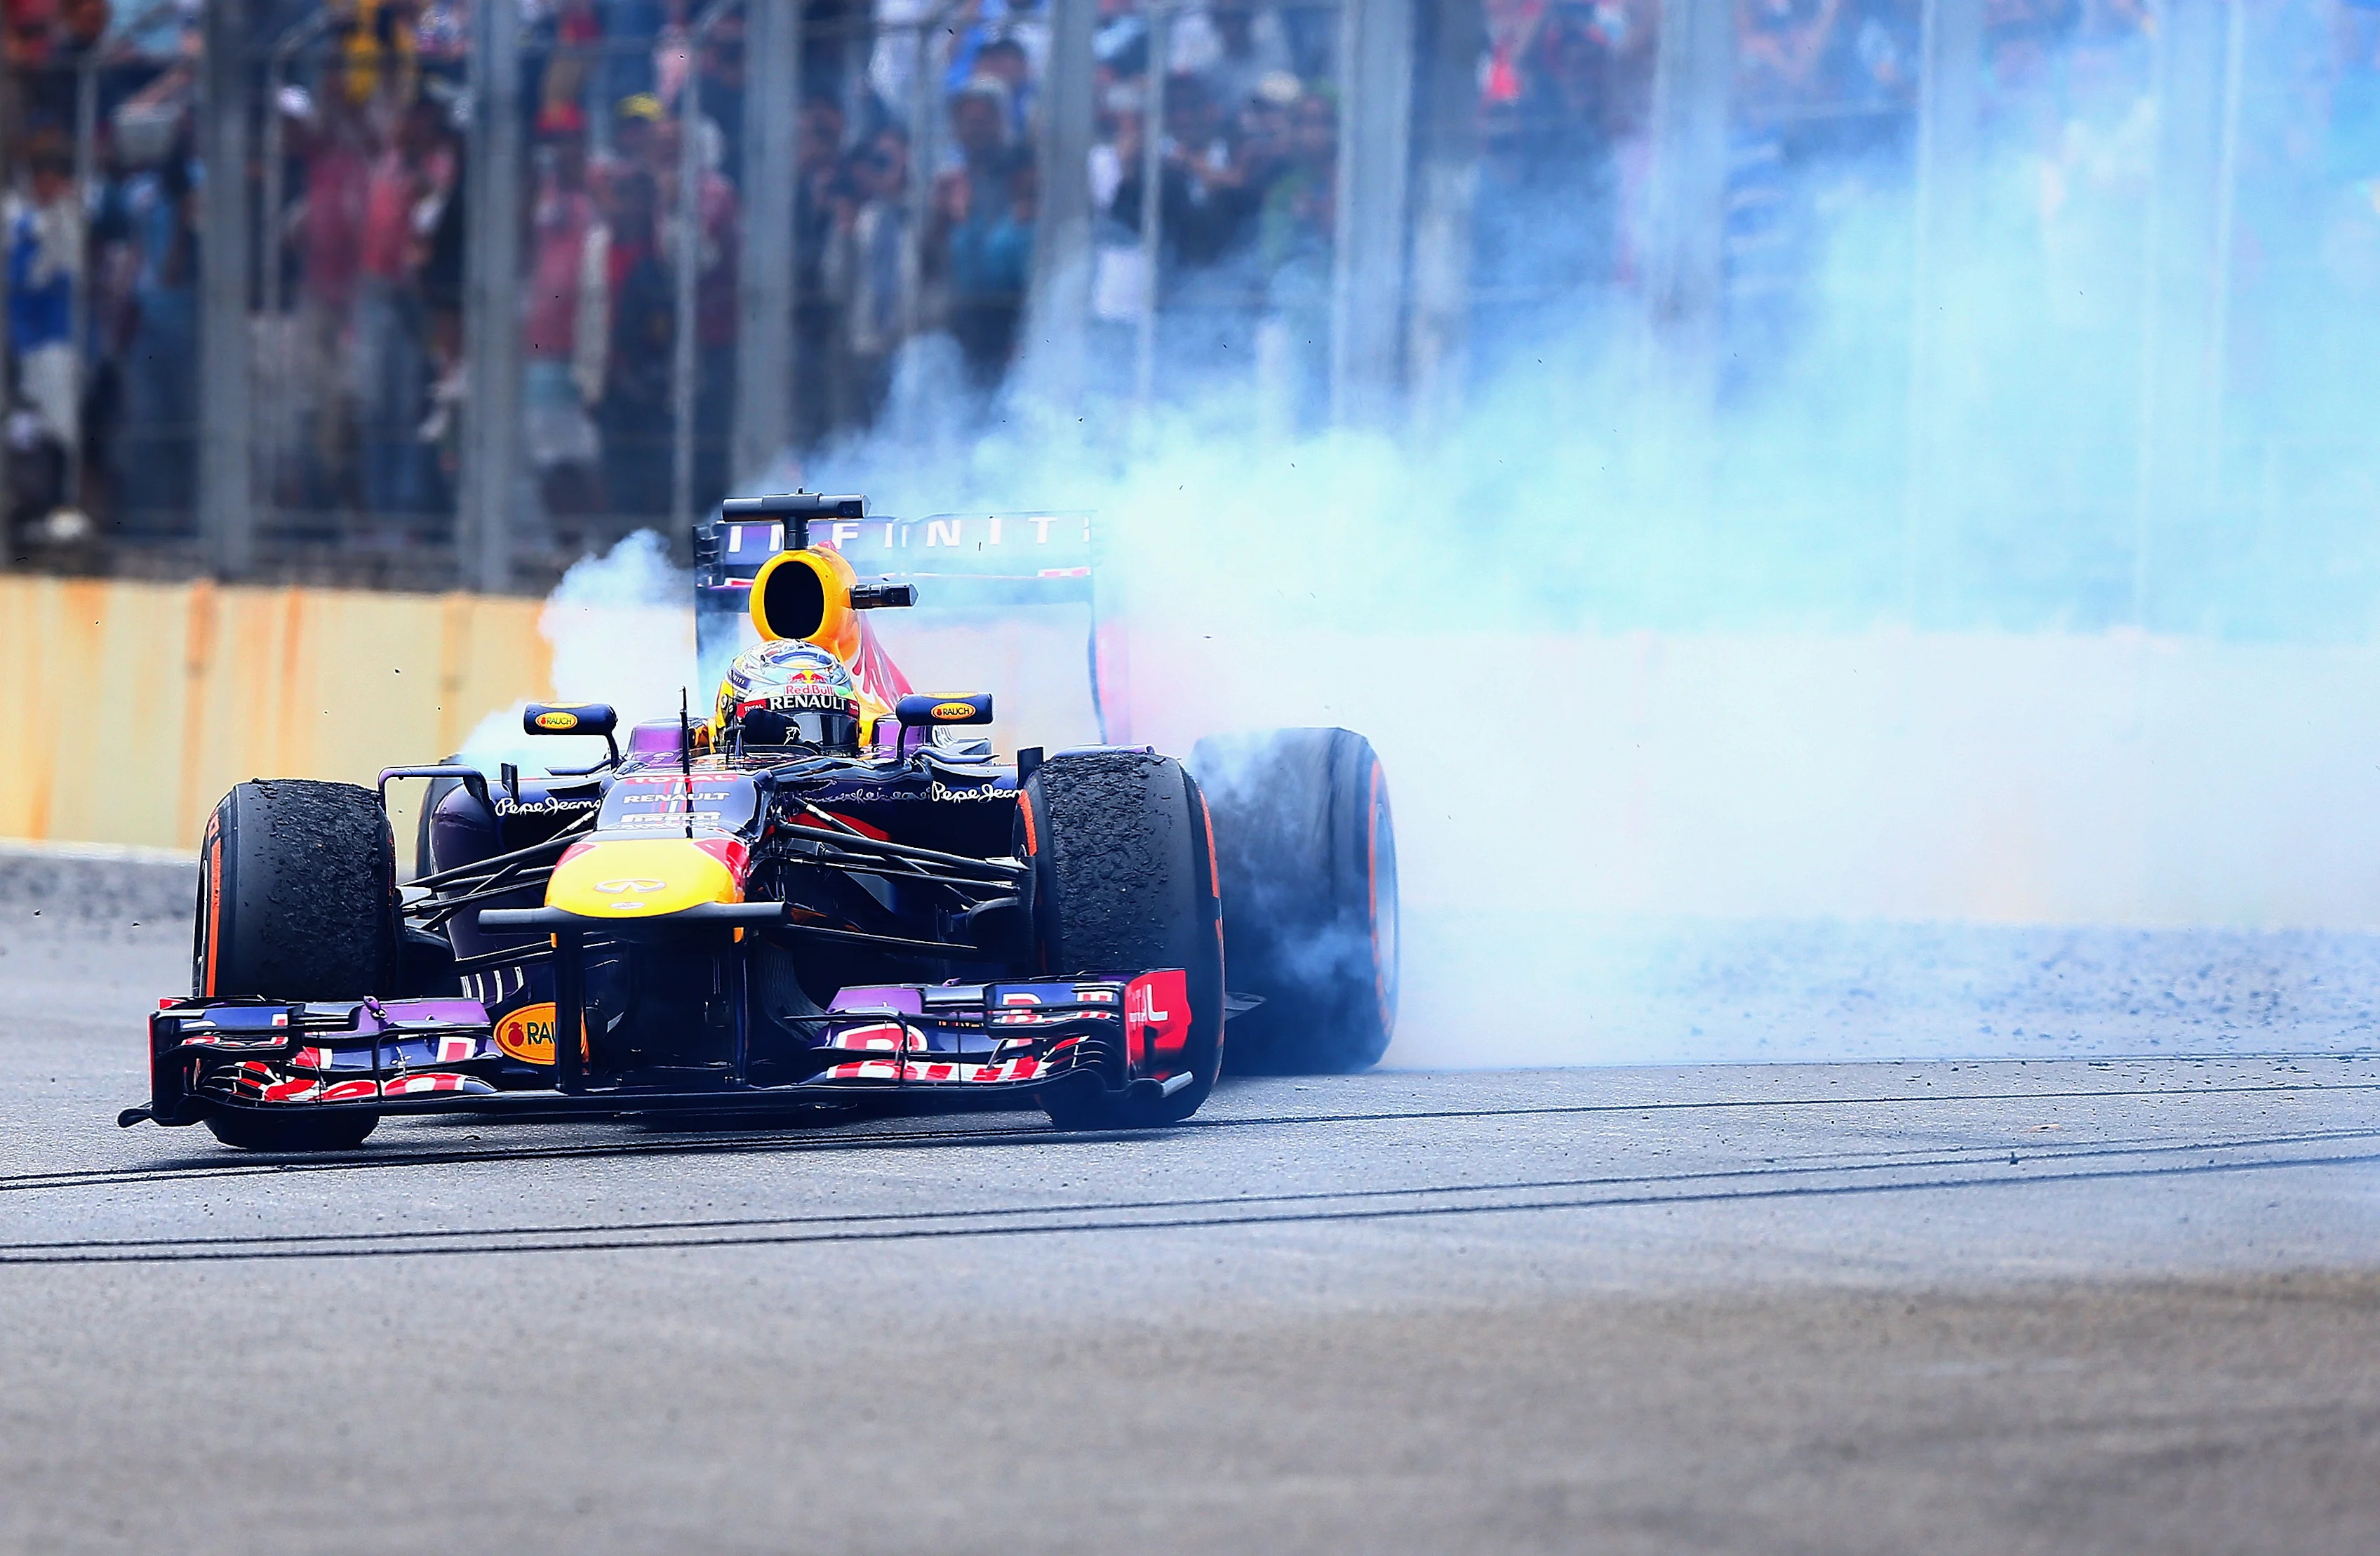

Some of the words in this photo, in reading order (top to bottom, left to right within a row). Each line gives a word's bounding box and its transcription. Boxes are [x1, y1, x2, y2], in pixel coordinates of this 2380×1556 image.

[785, 685, 810, 695] Red
[812, 685, 834, 696] Bull
[769, 694, 847, 711] RENAULT
[942, 707, 969, 716] RAUCH
[634, 773, 735, 784] TOTAL
[622, 792, 731, 804] RENAULT
[932, 780, 980, 804] Pepe
[978, 785, 1022, 803] Jean
[495, 797, 544, 817] Pepe
